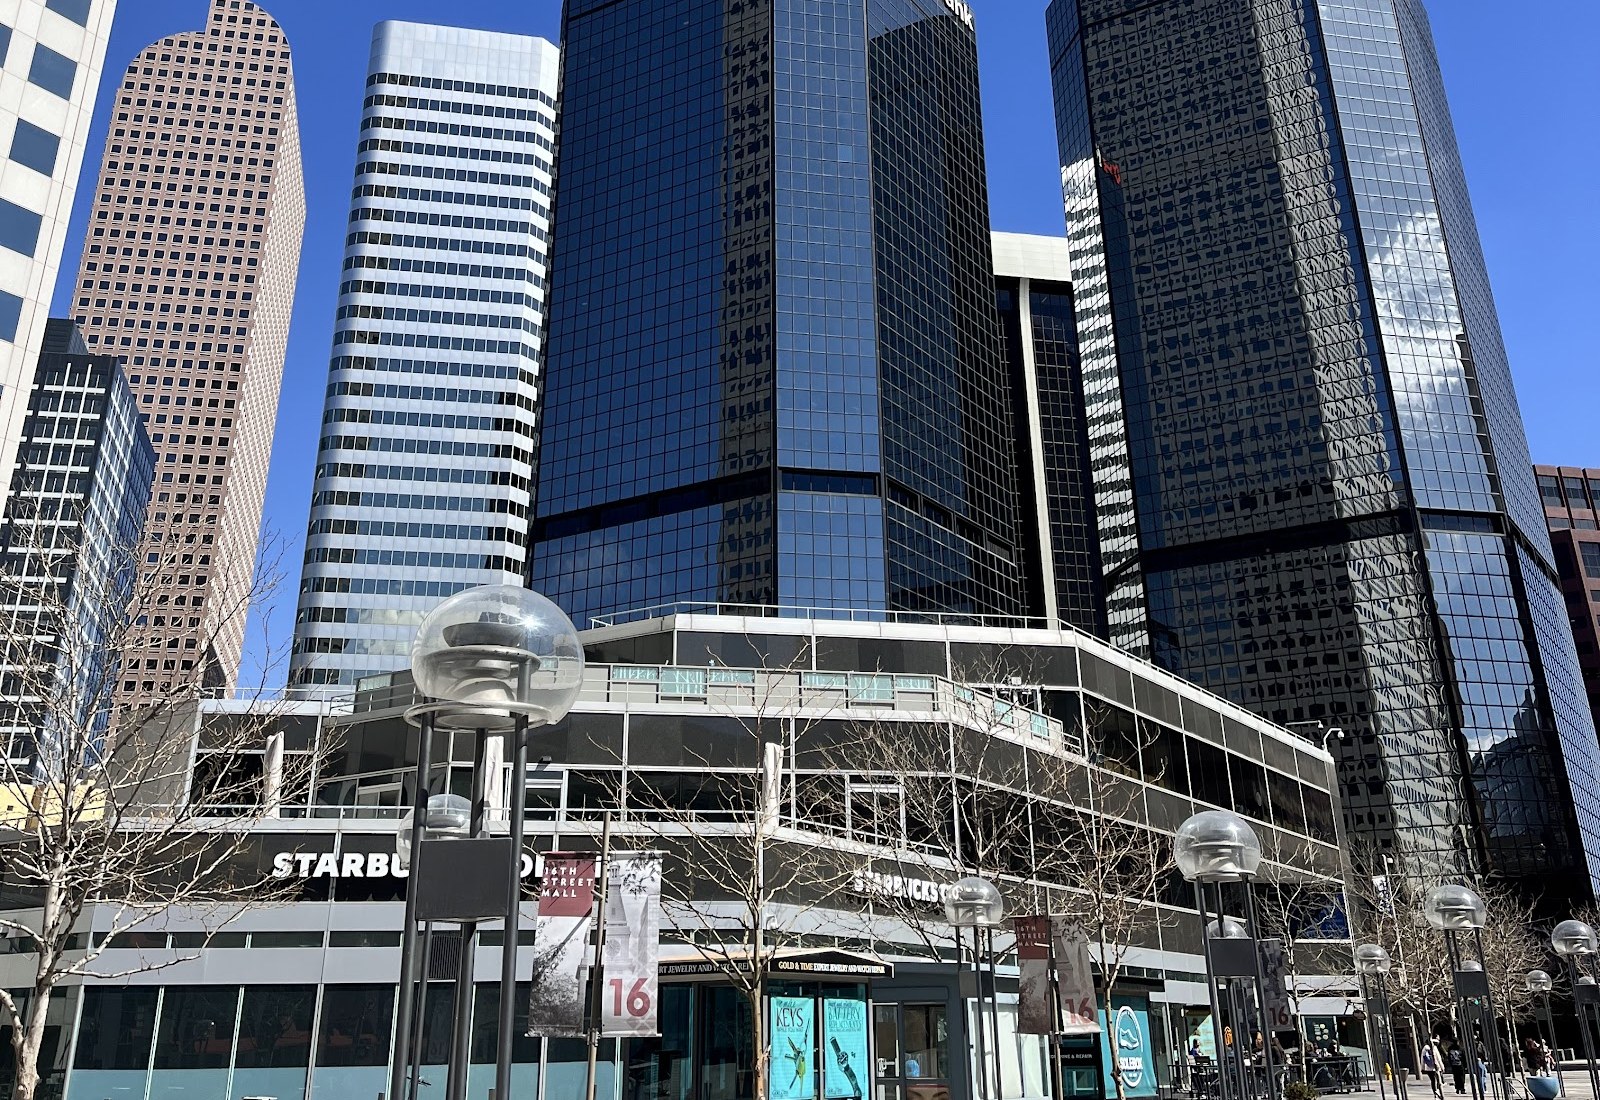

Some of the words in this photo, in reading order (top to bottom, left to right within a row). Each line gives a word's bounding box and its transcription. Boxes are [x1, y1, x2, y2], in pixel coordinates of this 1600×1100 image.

[272, 852, 410, 878] STARBU
[544, 866, 577, 876] 16TH
[542, 878, 594, 887] STREET
[541, 889, 577, 898] MALL
[668, 964, 697, 974] JEWELRY
[698, 963, 713, 972] AND
[778, 961, 795, 970] GOLD
[795, 962, 800, 970] &
[800, 963, 814, 971] TIME
[609, 977, 651, 1017] 16
[776, 1008, 804, 1027] KEYS
[1065, 997, 1094, 1024] 16
[1269, 1006, 1289, 1026] 16
